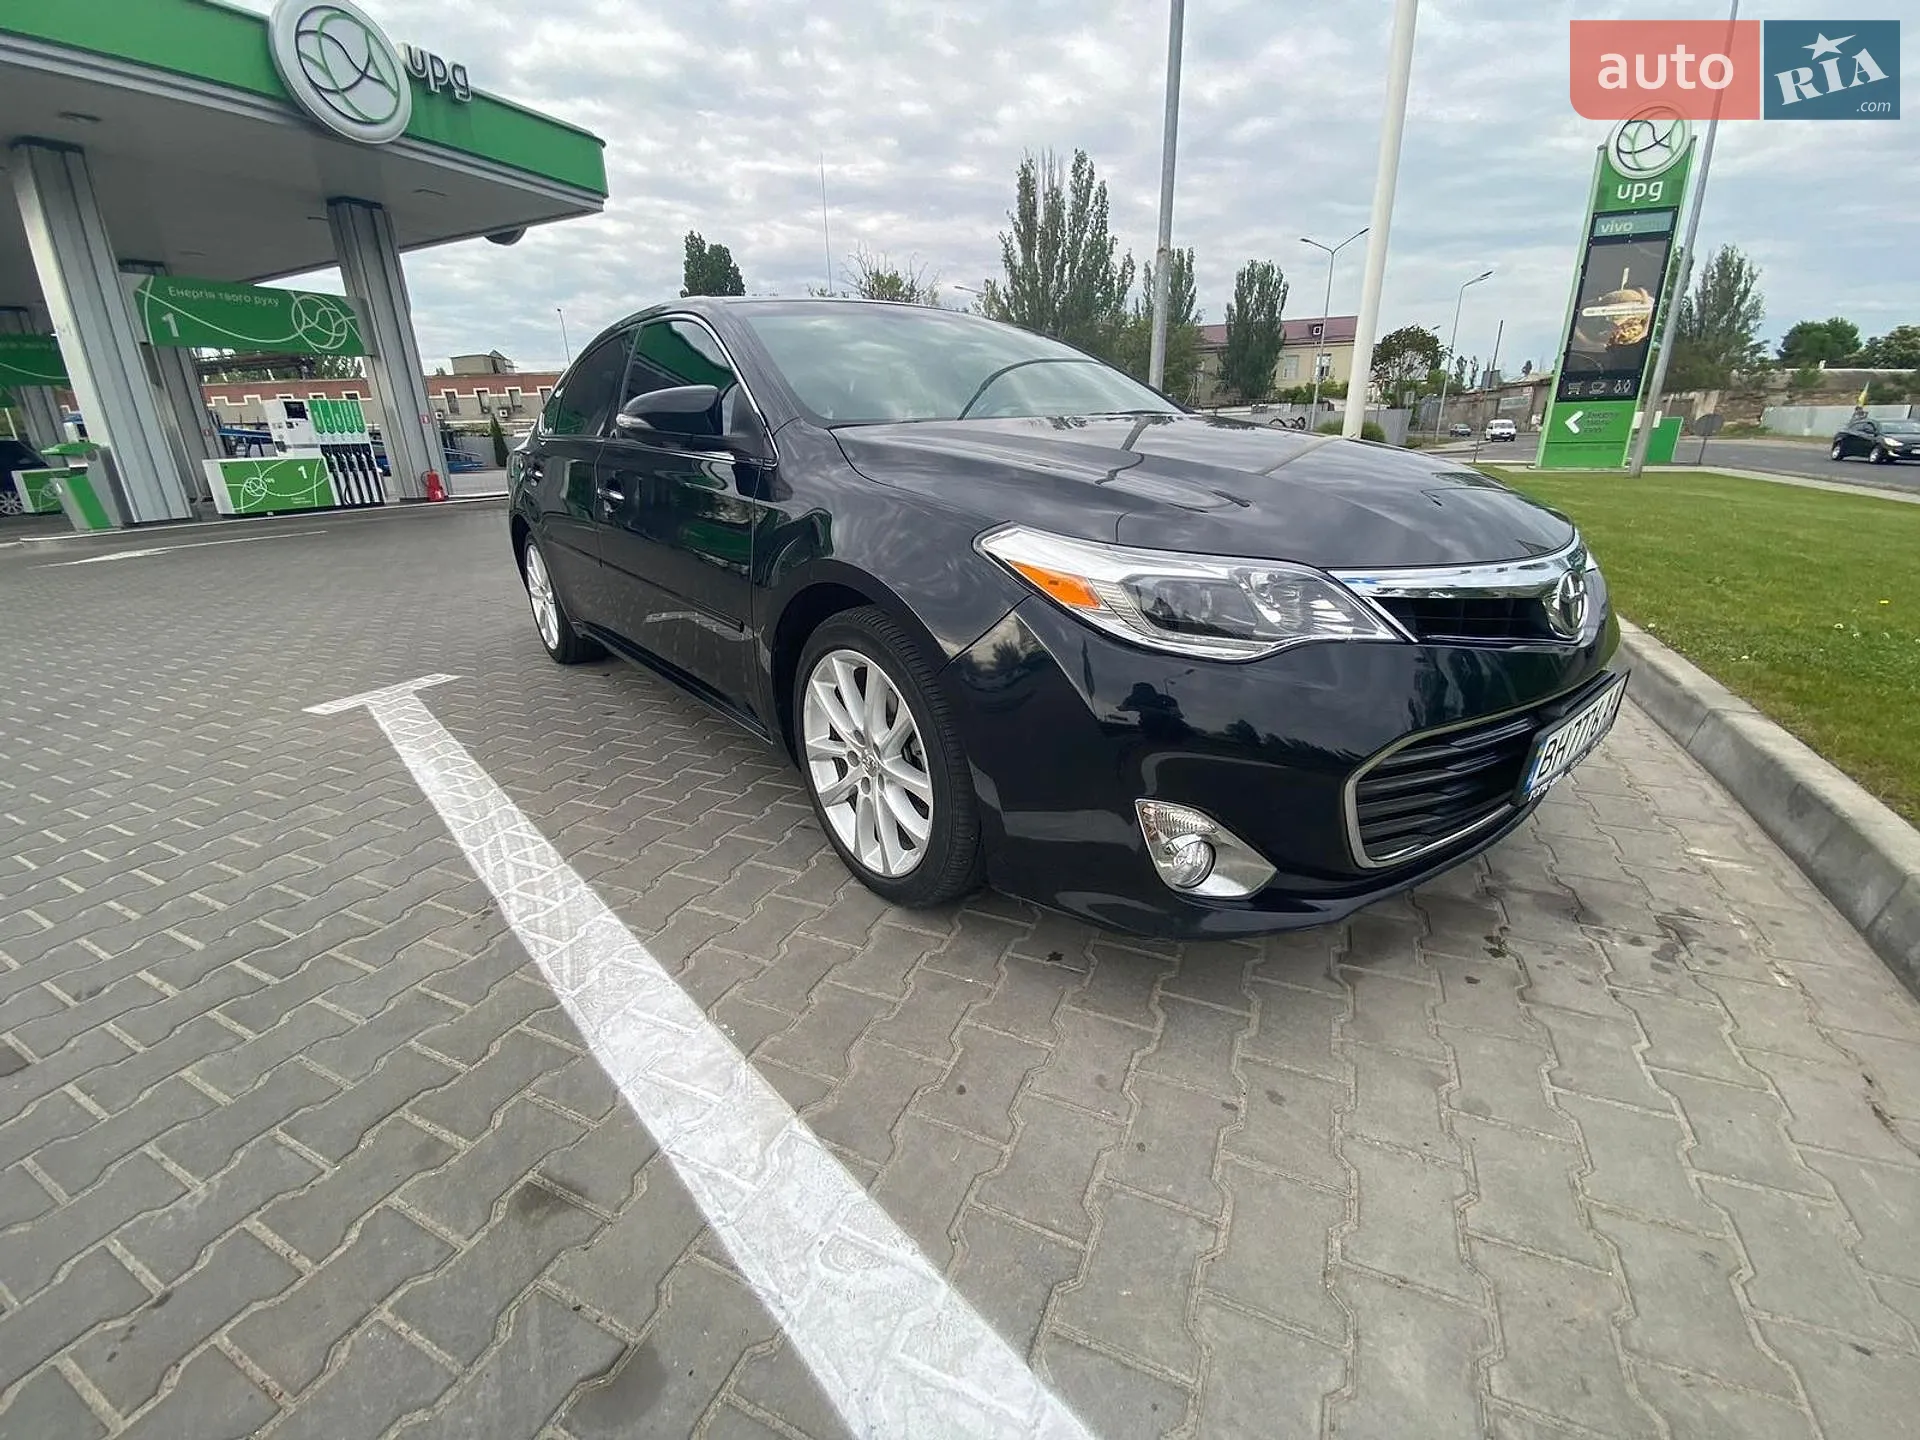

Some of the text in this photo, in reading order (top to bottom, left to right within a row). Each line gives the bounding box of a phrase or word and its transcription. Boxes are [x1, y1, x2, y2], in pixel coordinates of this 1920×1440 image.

[396, 40, 472, 102] upg
[1617, 181, 1664, 204] upg
[1601, 219, 1633, 233] vivo
[167, 285, 280, 307] Енергія твого руху
[162, 311, 180, 338] 1
[297, 465, 308, 479] 1
